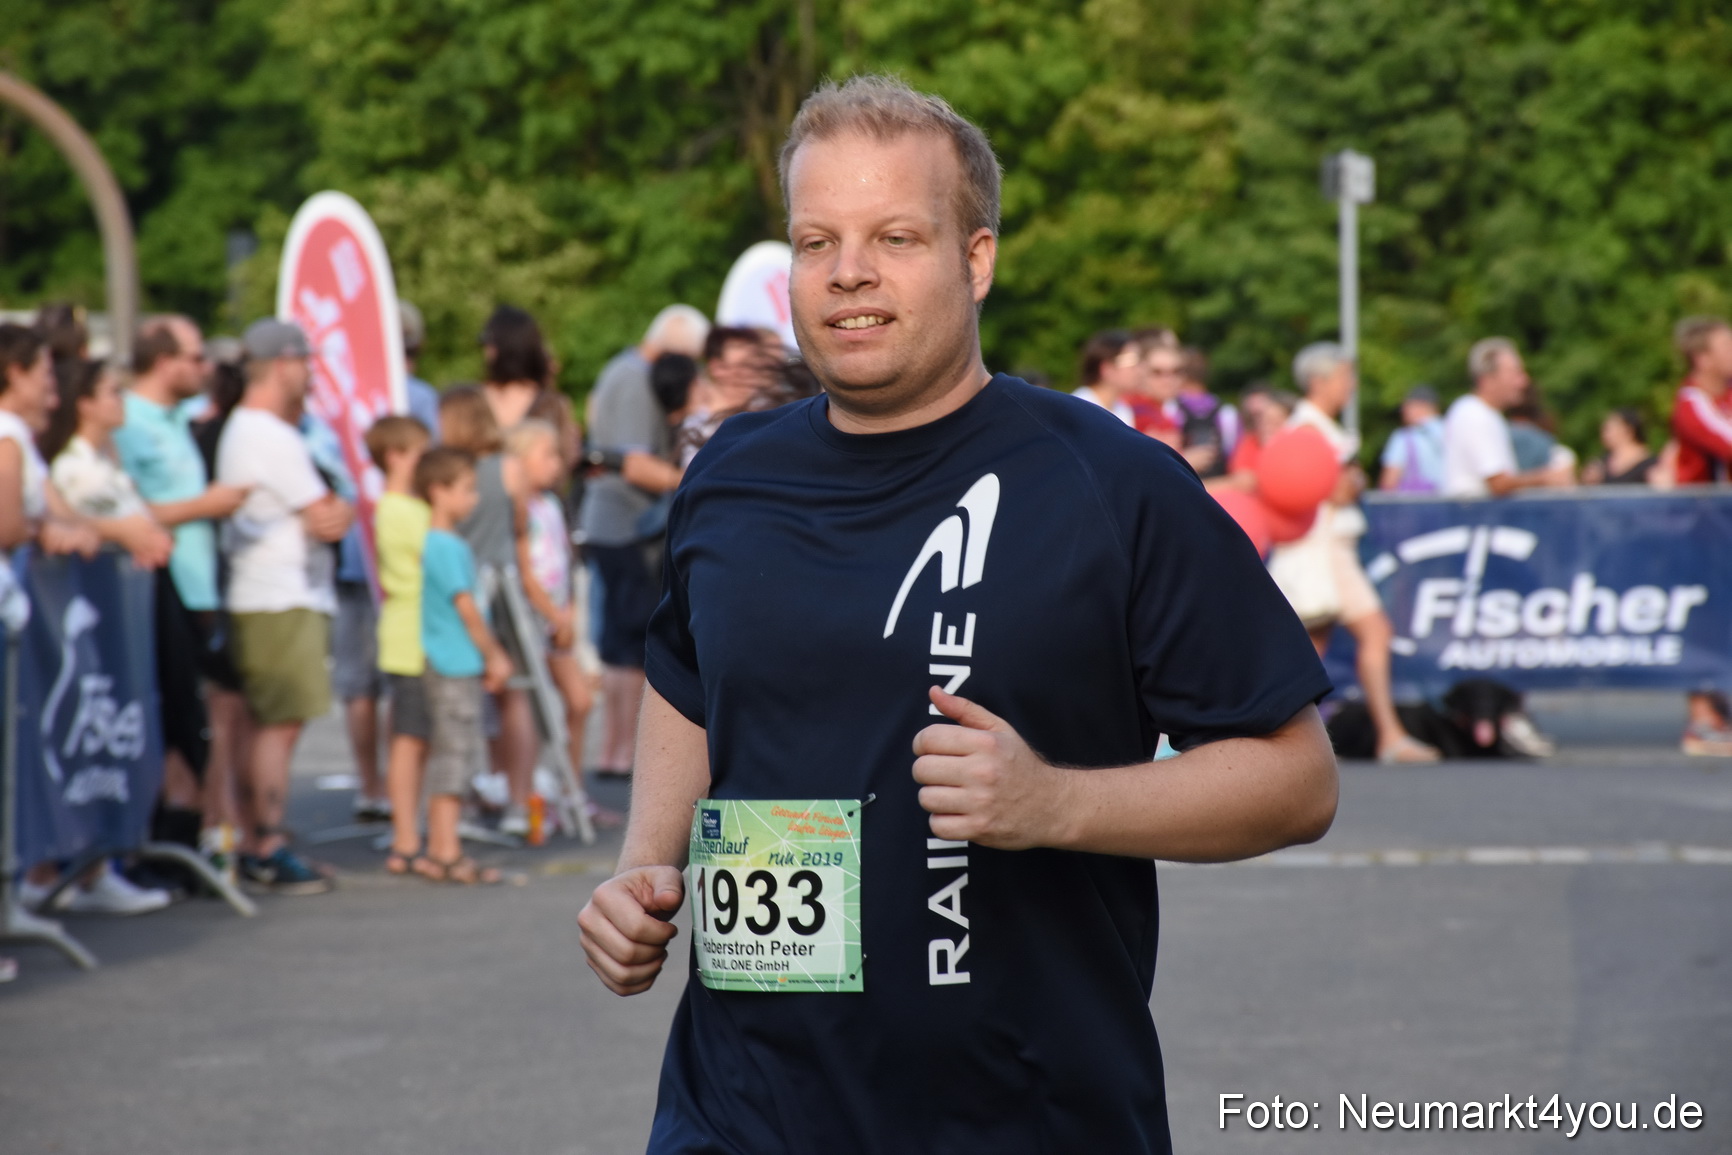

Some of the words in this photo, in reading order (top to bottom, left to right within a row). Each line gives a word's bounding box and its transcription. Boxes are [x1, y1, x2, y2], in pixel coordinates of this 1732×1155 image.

[1410, 571, 1708, 638] Fischer
[1438, 635, 1683, 670] AUTOMOBILE
[801, 851, 843, 867] 2019
[697, 867, 826, 936] 1933
[702, 938, 765, 956] Haberstroh
[770, 940, 816, 956] Peter
[755, 959, 790, 972] GmbH
